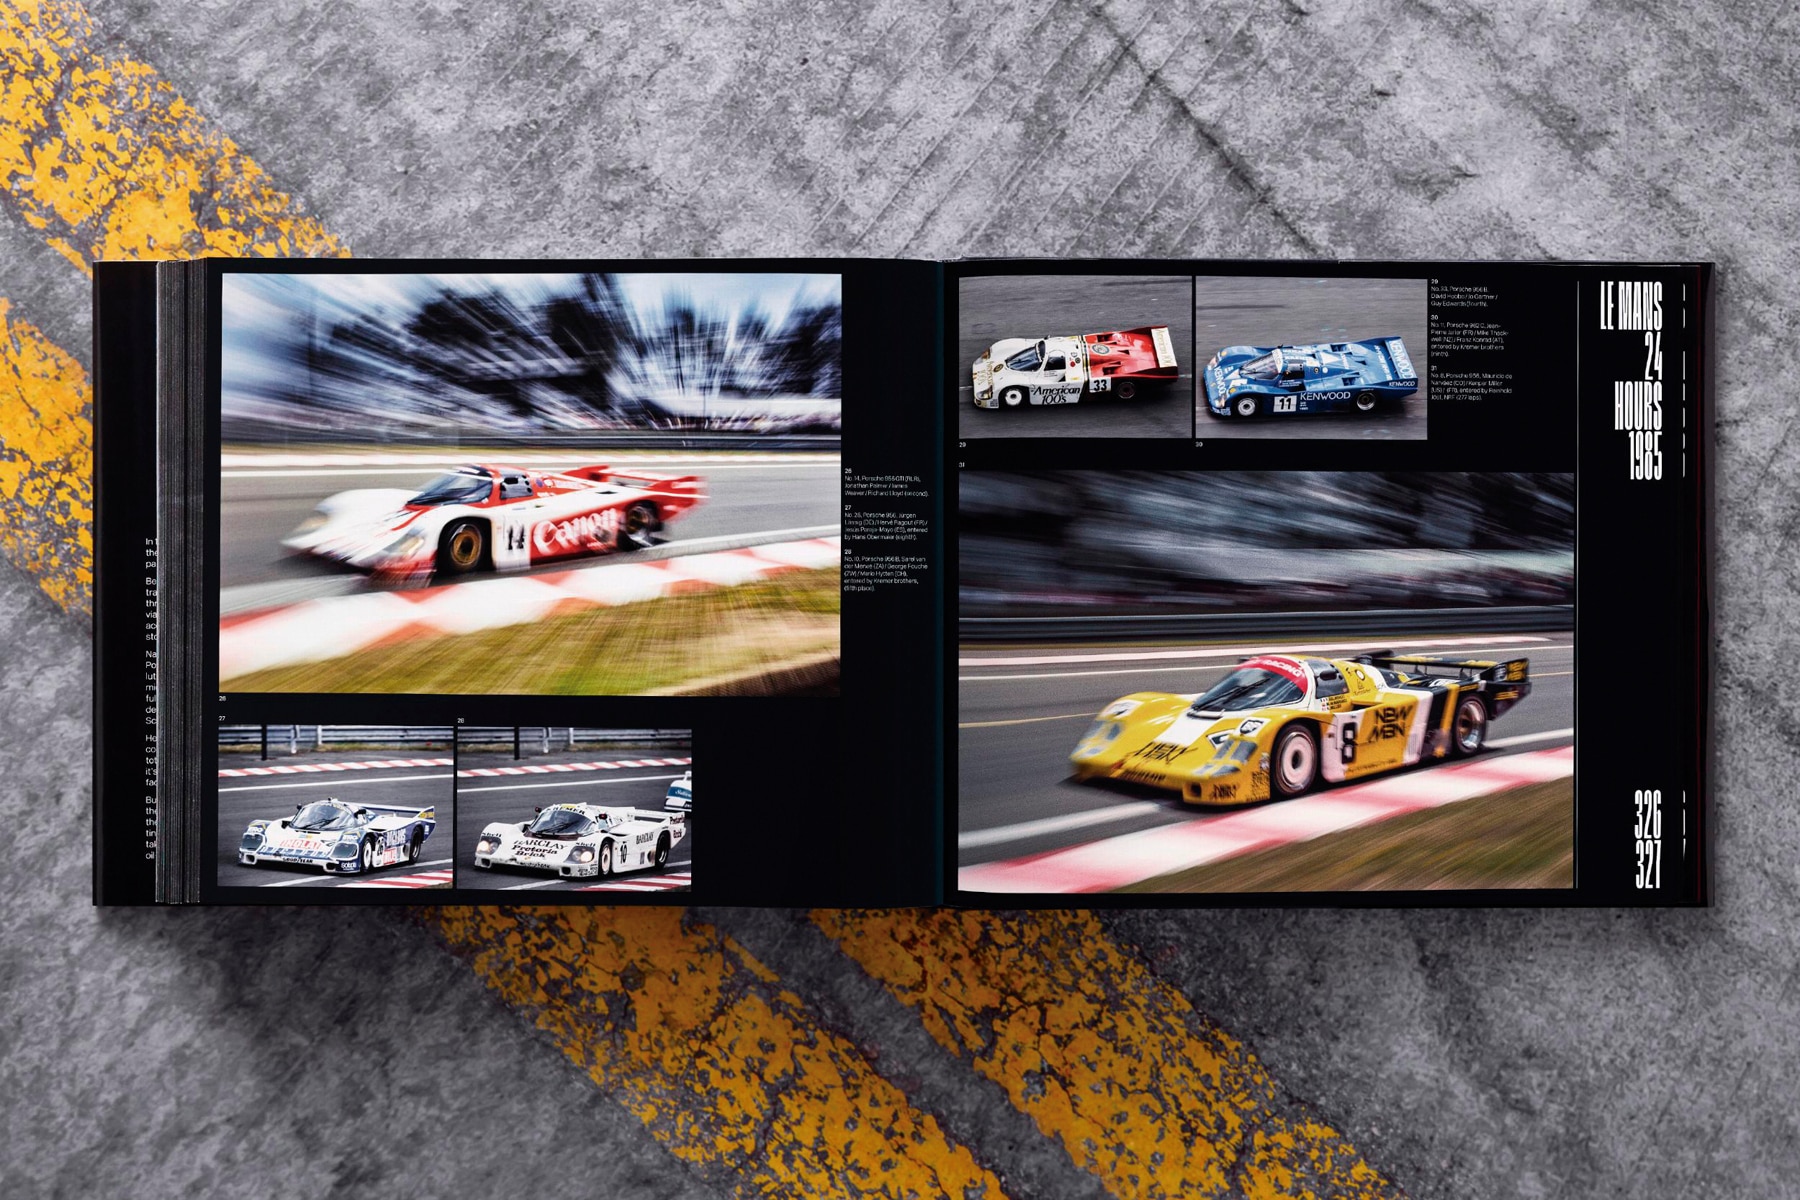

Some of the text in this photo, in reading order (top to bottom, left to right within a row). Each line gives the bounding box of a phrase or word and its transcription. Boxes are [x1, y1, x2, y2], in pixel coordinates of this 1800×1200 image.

[1600, 281, 1663, 331] LE MANS
[1389, 340, 1414, 380] KENWOOD
[1644, 331, 1663, 380] 24
[1031, 382, 1080, 396] American
[1094, 380, 1107, 391] 33
[1280, 398, 1292, 410] 11
[1300, 392, 1350, 400] KENWOOD
[1614, 381, 1663, 430] HOURS
[1628, 430, 1663, 480] 1985
[507, 524, 525, 550] 14
[533, 508, 617, 555] Canon
[1342, 722, 1356, 764] 8
[1634, 789, 1662, 840] 326
[512, 845, 558, 855] Pretoria
[620, 842, 628, 865] 10
[636, 832, 654, 844] BARCLAY
[1635, 840, 1662, 890] 327
